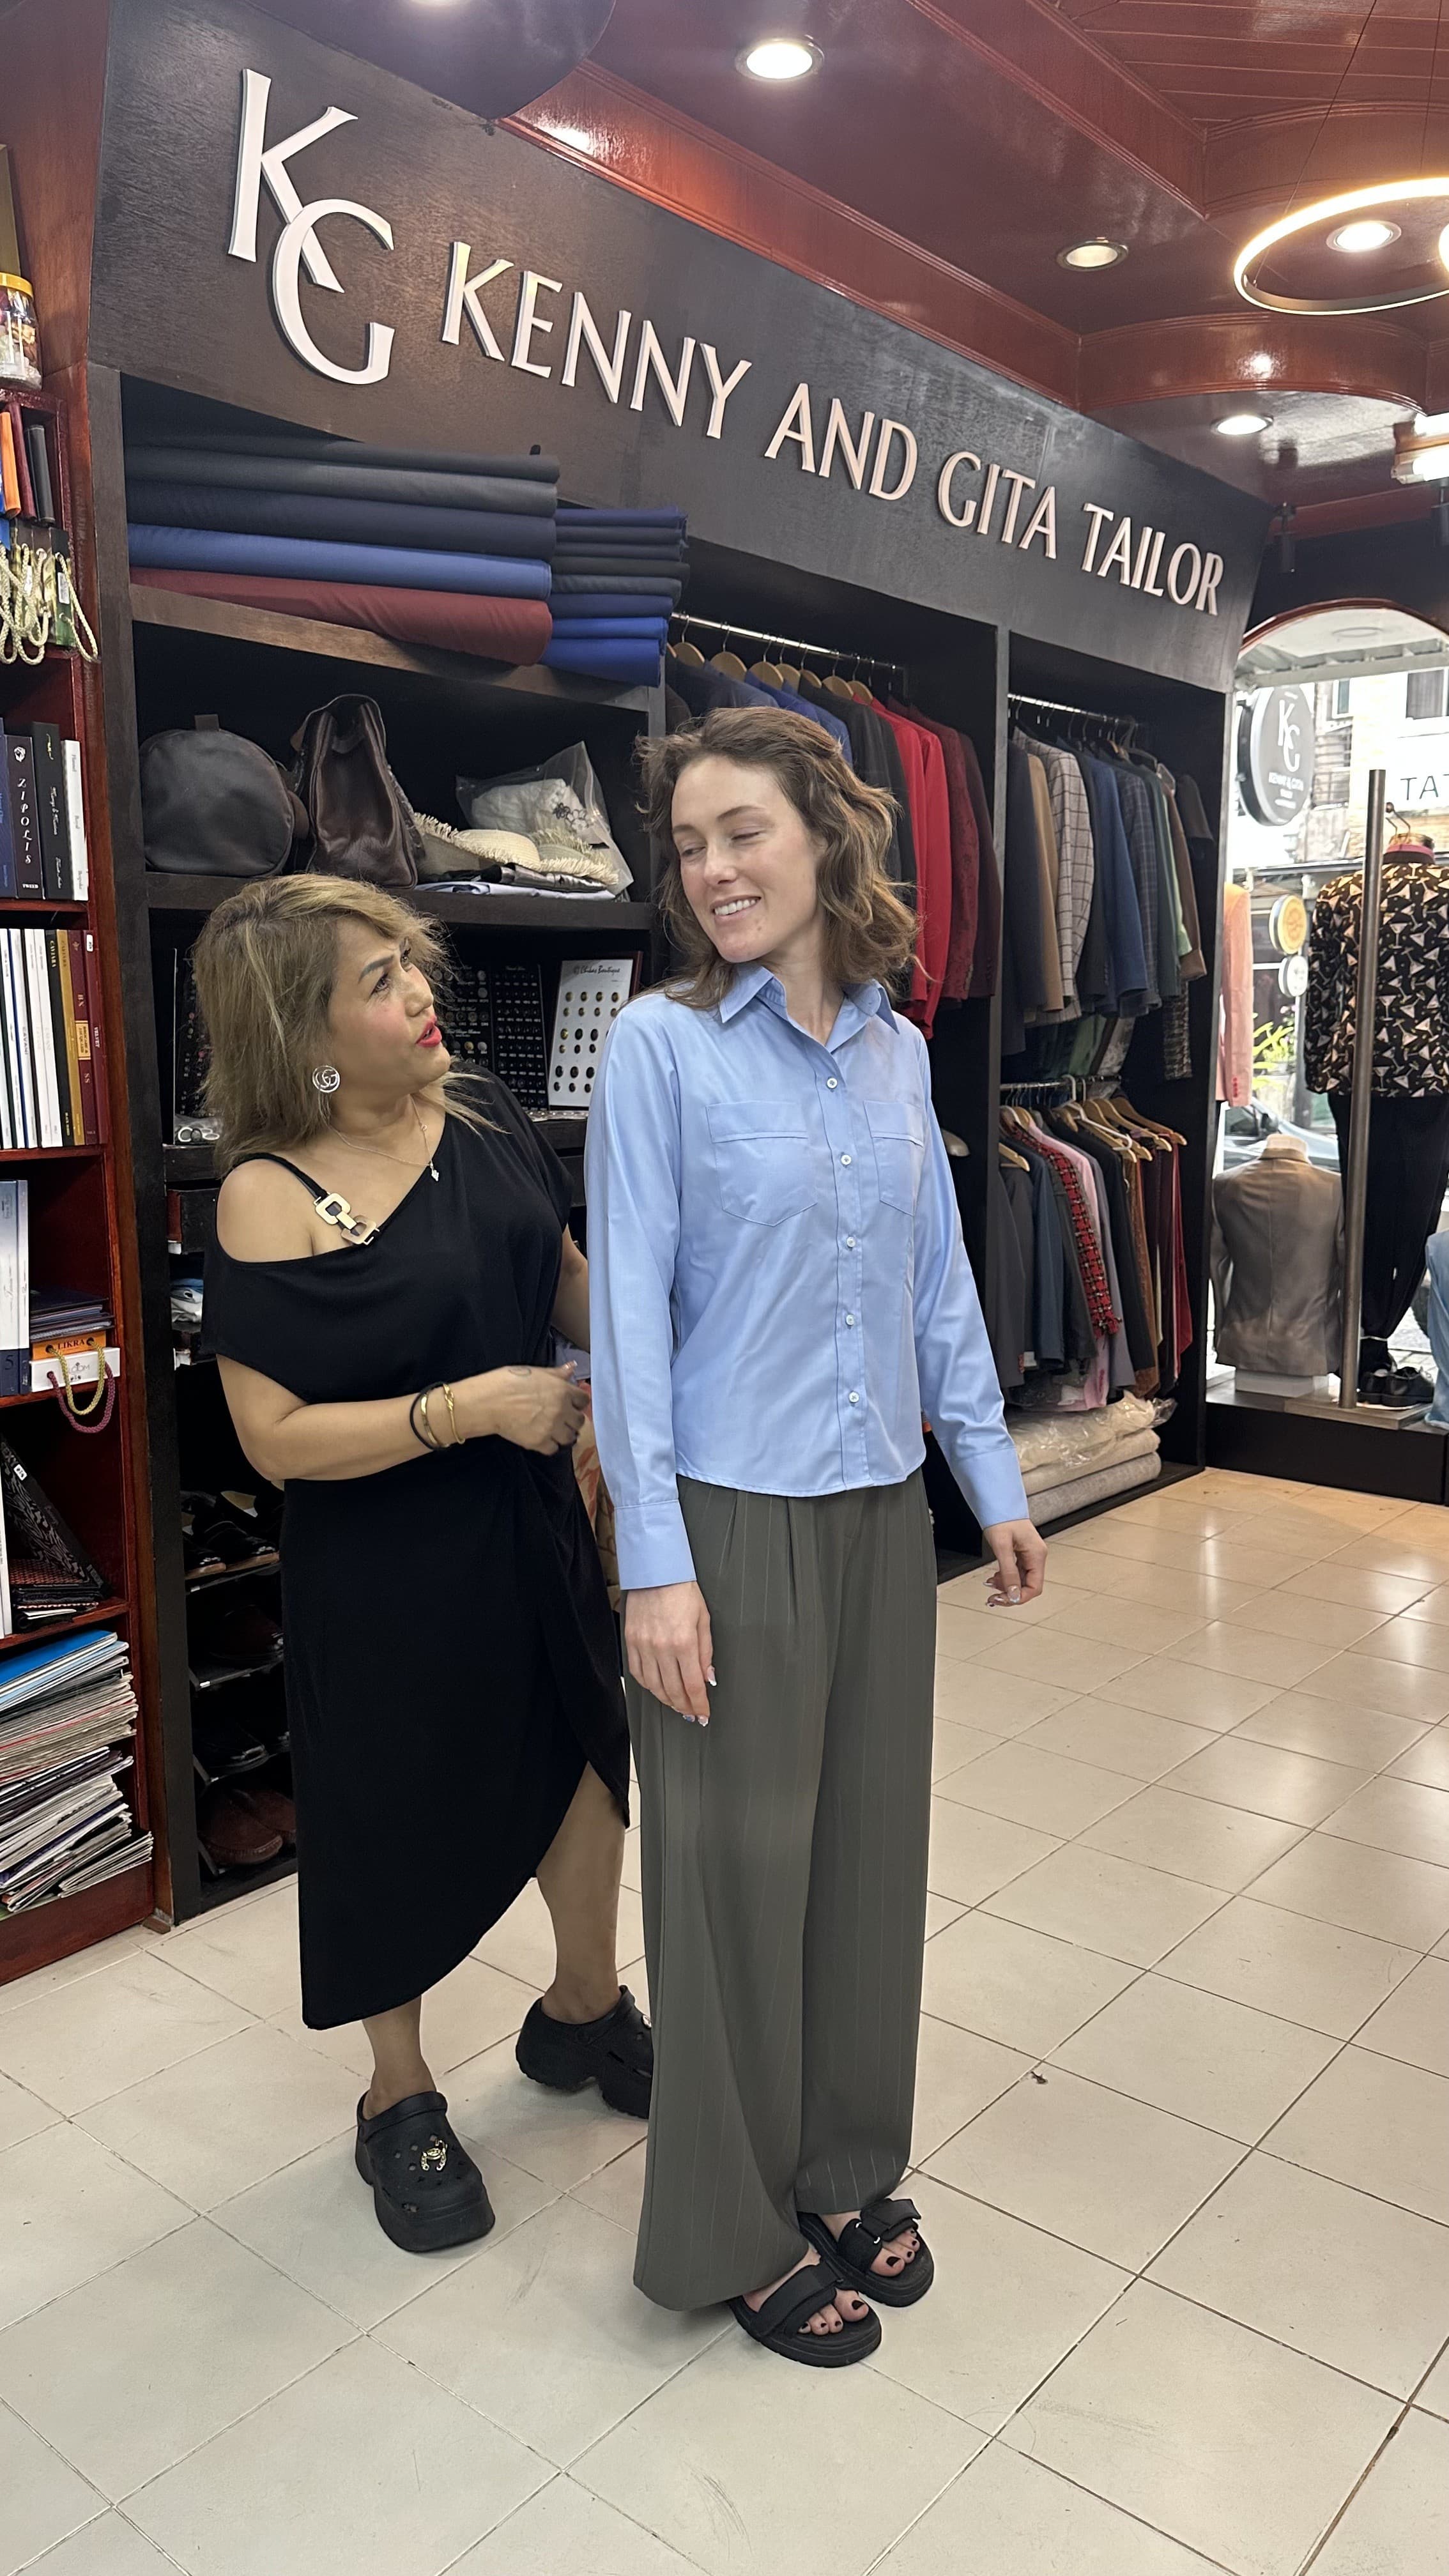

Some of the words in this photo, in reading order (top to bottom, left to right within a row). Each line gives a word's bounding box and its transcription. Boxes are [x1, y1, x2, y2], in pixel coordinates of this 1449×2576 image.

[441, 241, 752, 439] KENNY
[765, 383, 918, 500] AND
[938, 451, 1057, 558] GITA
[1082, 503, 1225, 615] TAILOR
[17, 778, 32, 864] ZIPOLIS
[5, 1354, 14, 1370] 5
[57, 1338, 86, 1350] LIKRA
